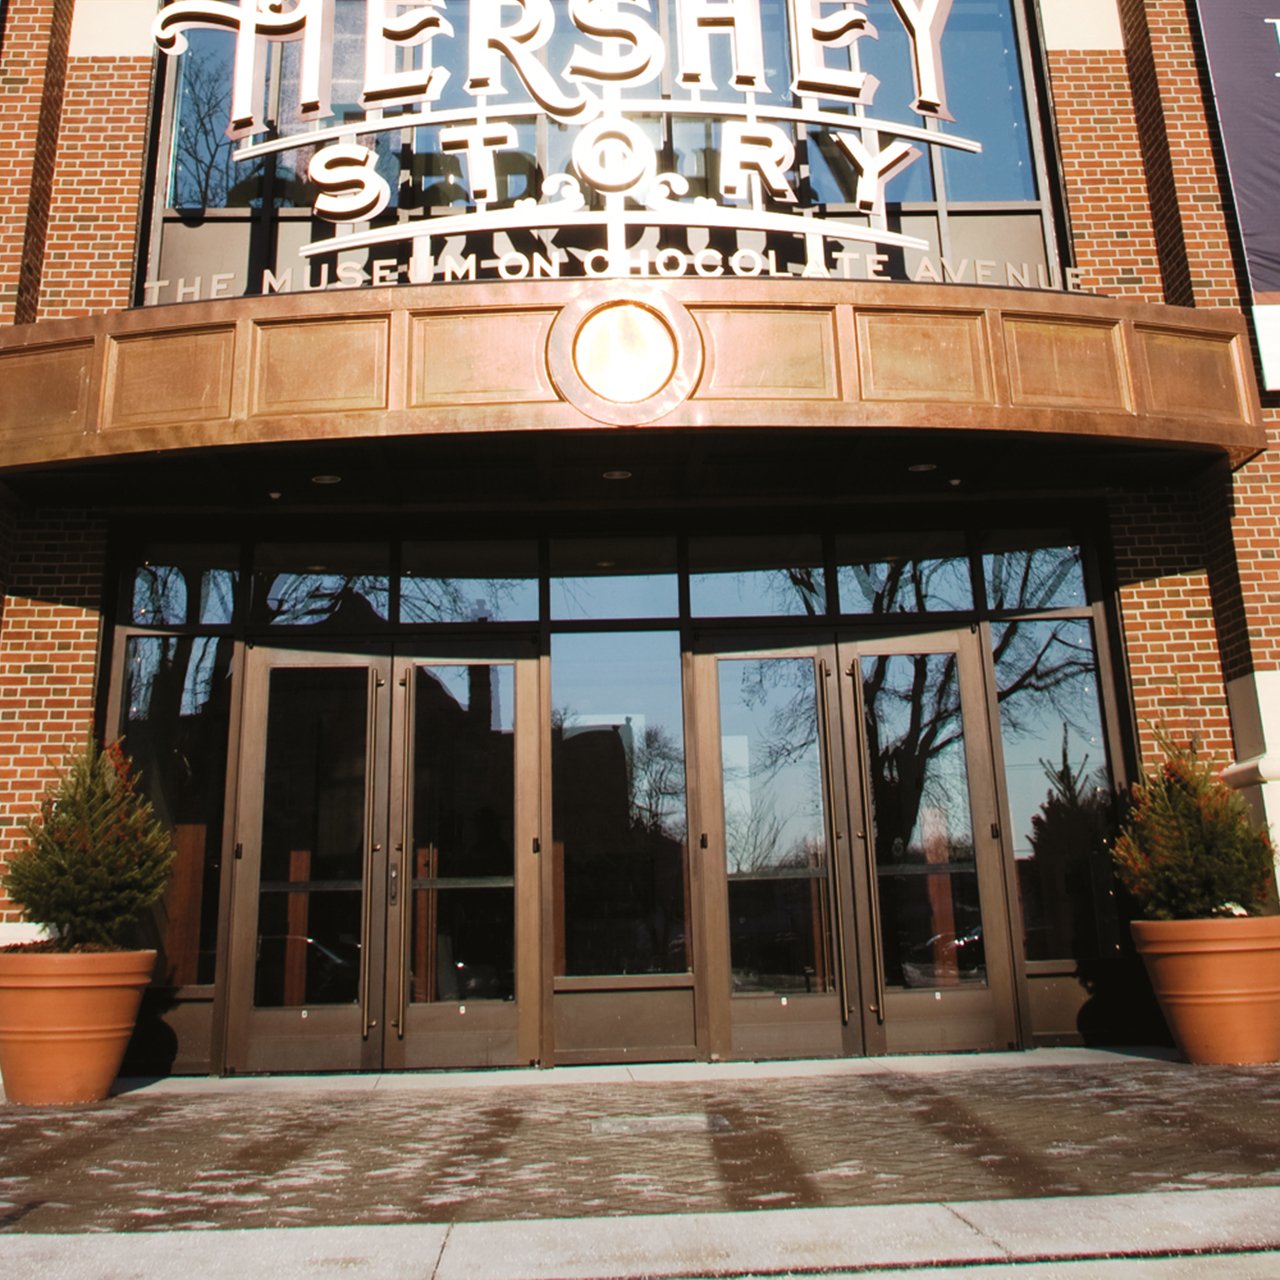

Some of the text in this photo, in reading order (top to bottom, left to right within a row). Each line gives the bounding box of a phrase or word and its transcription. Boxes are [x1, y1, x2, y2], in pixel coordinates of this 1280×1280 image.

[308, 120, 921, 222] STORY
[144, 247, 1089, 307] THE MUSEUM ON CHOCOLATE AVENUE
